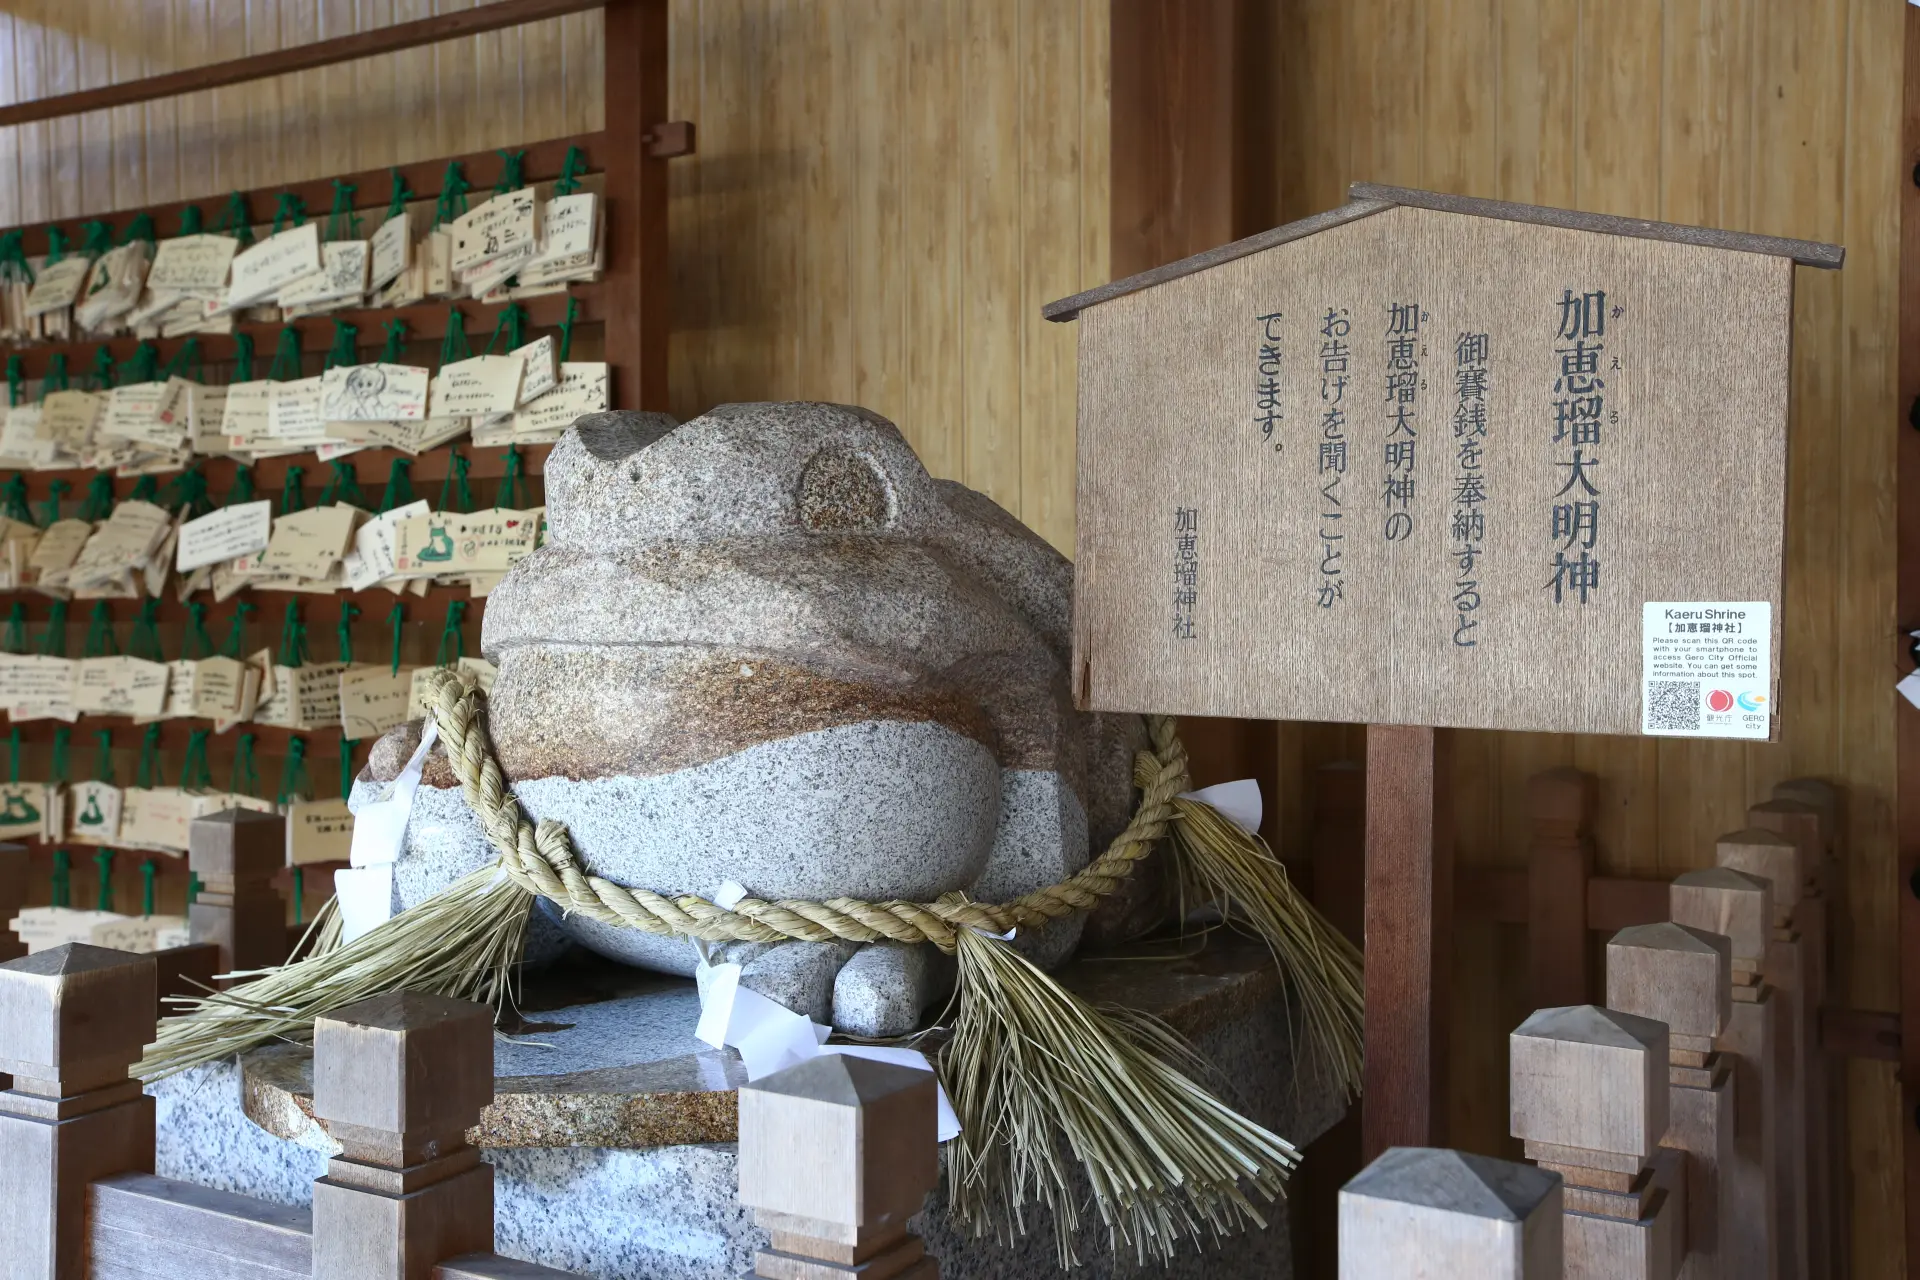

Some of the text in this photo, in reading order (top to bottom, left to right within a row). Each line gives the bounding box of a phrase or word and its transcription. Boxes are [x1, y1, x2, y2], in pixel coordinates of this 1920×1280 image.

[1253, 312, 1285, 453] できます。
[1317, 307, 1351, 609] お告げを聞くことが
[1379, 302, 1420, 543] 加恵瑠大明神の
[1451, 331, 1489, 647] 御賽銭を奉納すると
[1542, 289, 1606, 605] 加恵瑠大明神
[1171, 506, 1198, 640] 加恵瑠神社
[1665, 609, 1746, 619] Kaeru Shrine
